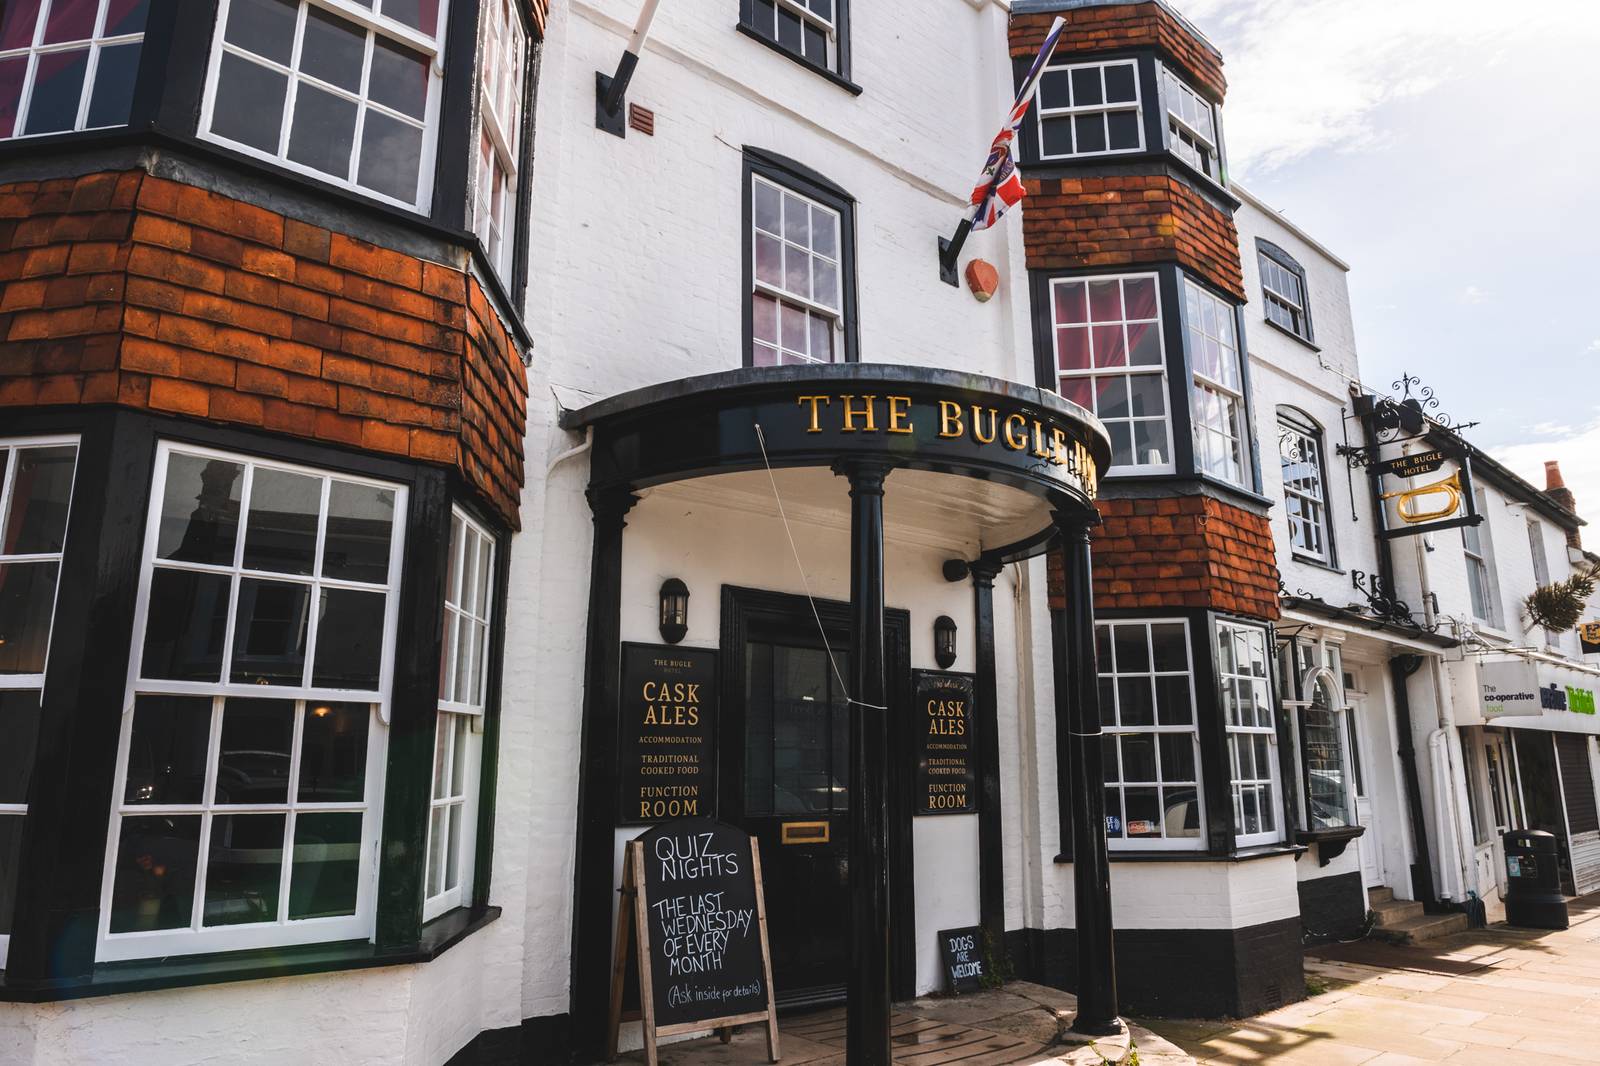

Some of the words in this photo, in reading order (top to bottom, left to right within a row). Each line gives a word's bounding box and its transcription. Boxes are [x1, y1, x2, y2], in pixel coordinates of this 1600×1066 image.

[798, 395, 913, 433] THE
[938, 400, 1067, 464] BUGLE
[1391, 460, 1408, 469] THE
[1414, 452, 1443, 464] BUGLE
[1403, 464, 1431, 476] HOTEL
[670, 660, 692, 668] BUGLE
[643, 681, 700, 703] CASK
[1483, 685, 1496, 693] The
[1484, 692, 1535, 702] co-operative
[643, 705, 700, 726] ALES
[927, 700, 965, 717] CASK
[929, 719, 965, 736] ALES
[639, 736, 702, 744] ACCOMMODATION
[641, 755, 699, 763] TRADITIONAL
[640, 767, 674, 775] COOKED
[640, 786, 698, 797] FUNCTION
[928, 783, 966, 793] FUNCTION
[640, 800, 698, 818] ROOM
[928, 795, 966, 809] ROOM
[655, 832, 718, 863] QUIZ
[662, 853, 739, 881] NIGHTS
[652, 897, 687, 919] THE
[690, 892, 725, 915] LAST
[661, 909, 753, 938] WEDNESDAY
[663, 937, 682, 958] OF
[686, 930, 730, 955] EVERY
[949, 935, 974, 952] DOGS
[670, 951, 723, 976] MONTH
[956, 951, 969, 962] ARE
[951, 961, 982, 978] WELCOME
[668, 984, 692, 1008] (Ask
[695, 985, 720, 1001] inside
[722, 989, 733, 1002] for
[733, 979, 761, 998] details)
